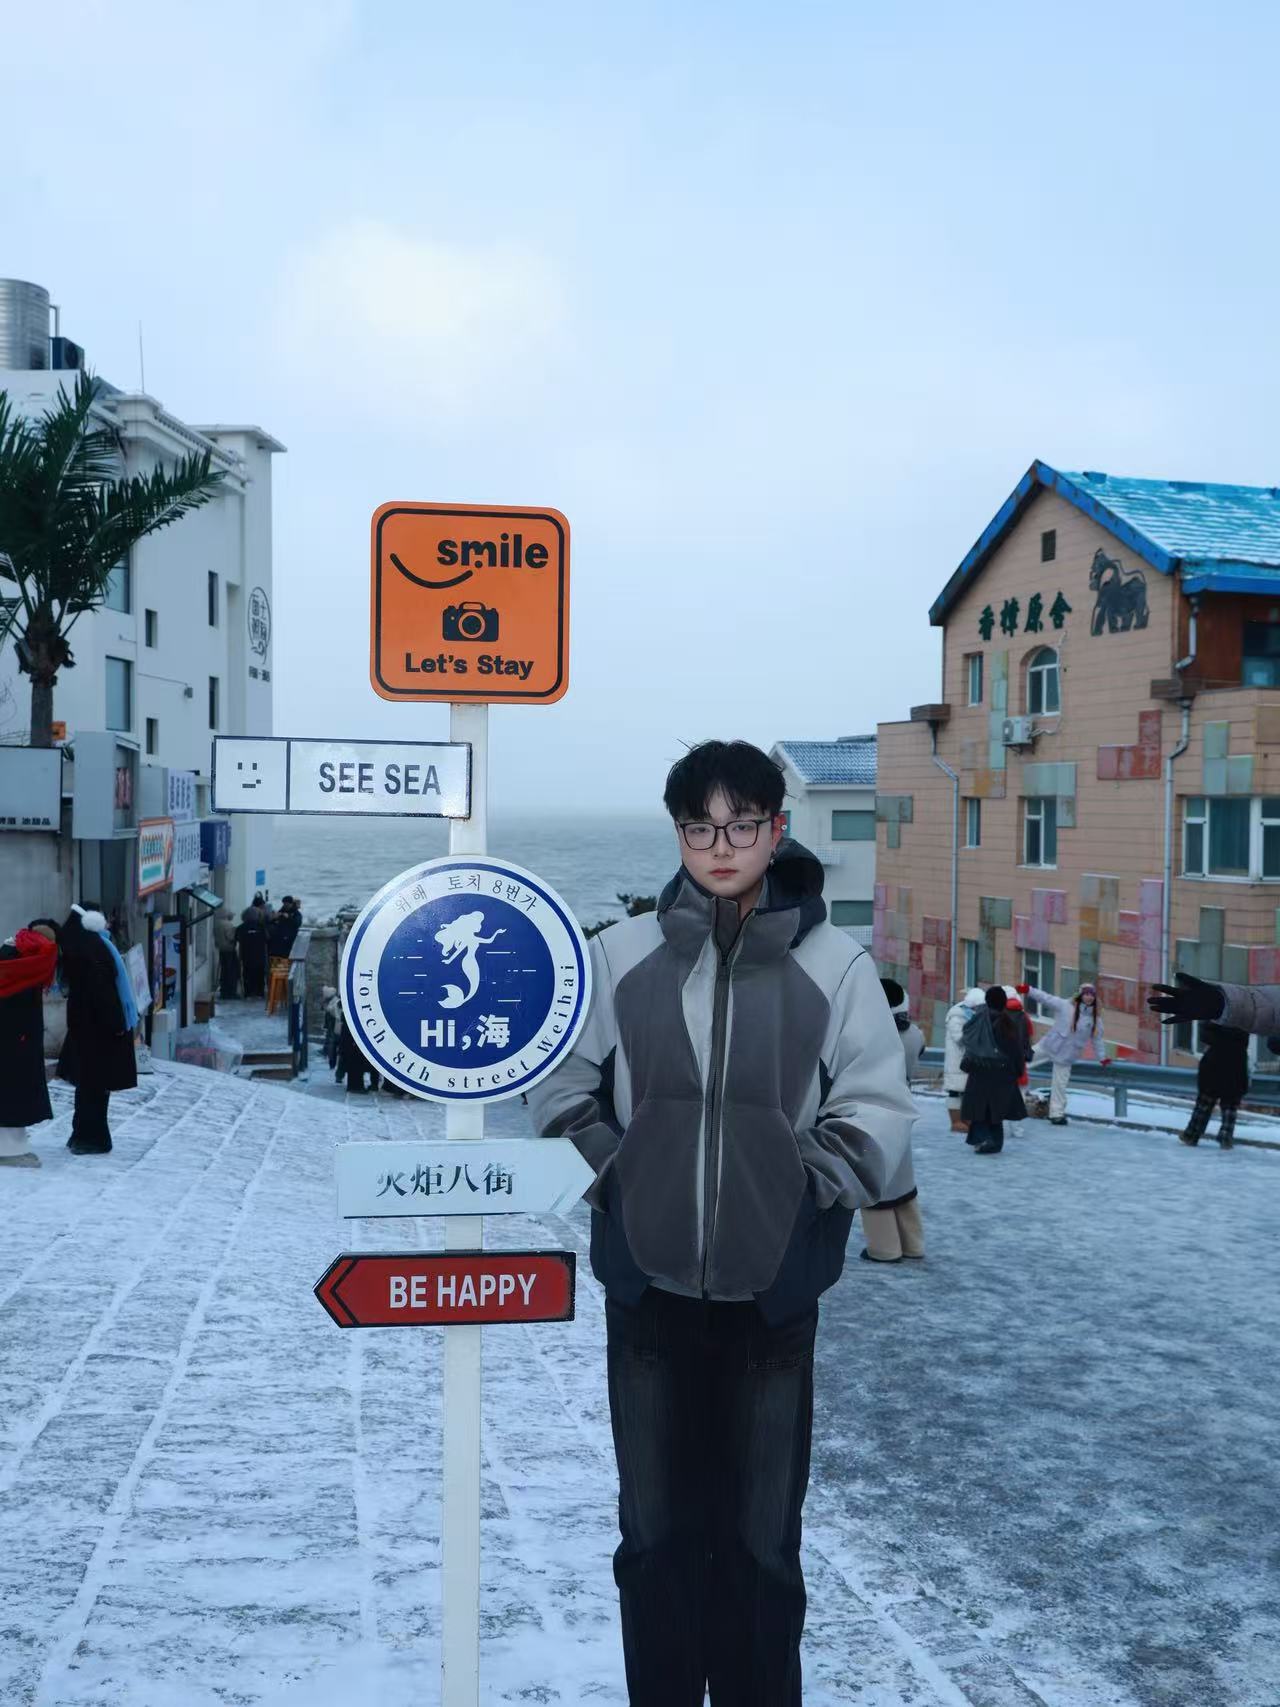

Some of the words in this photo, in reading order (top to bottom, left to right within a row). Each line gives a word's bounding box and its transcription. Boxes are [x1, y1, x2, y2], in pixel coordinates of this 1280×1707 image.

[437, 532, 549, 569] smile
[405, 652, 468, 674] Let's
[477, 654, 535, 681] Stay
[318, 761, 375, 795] SEE
[384, 763, 442, 796] SEA
[394, 884, 428, 913] 위해
[447, 873, 482, 891] 토치
[491, 879, 538, 913] 8번가
[359, 969, 389, 1046] Torch
[392, 1050, 431, 1083] 8th
[447, 1058, 530, 1090] street
[536, 963, 576, 1055] Weihai
[375, 1162, 517, 1198] 火炬八街
[389, 1275, 428, 1309] BE
[437, 1273, 537, 1308] HAPPY
